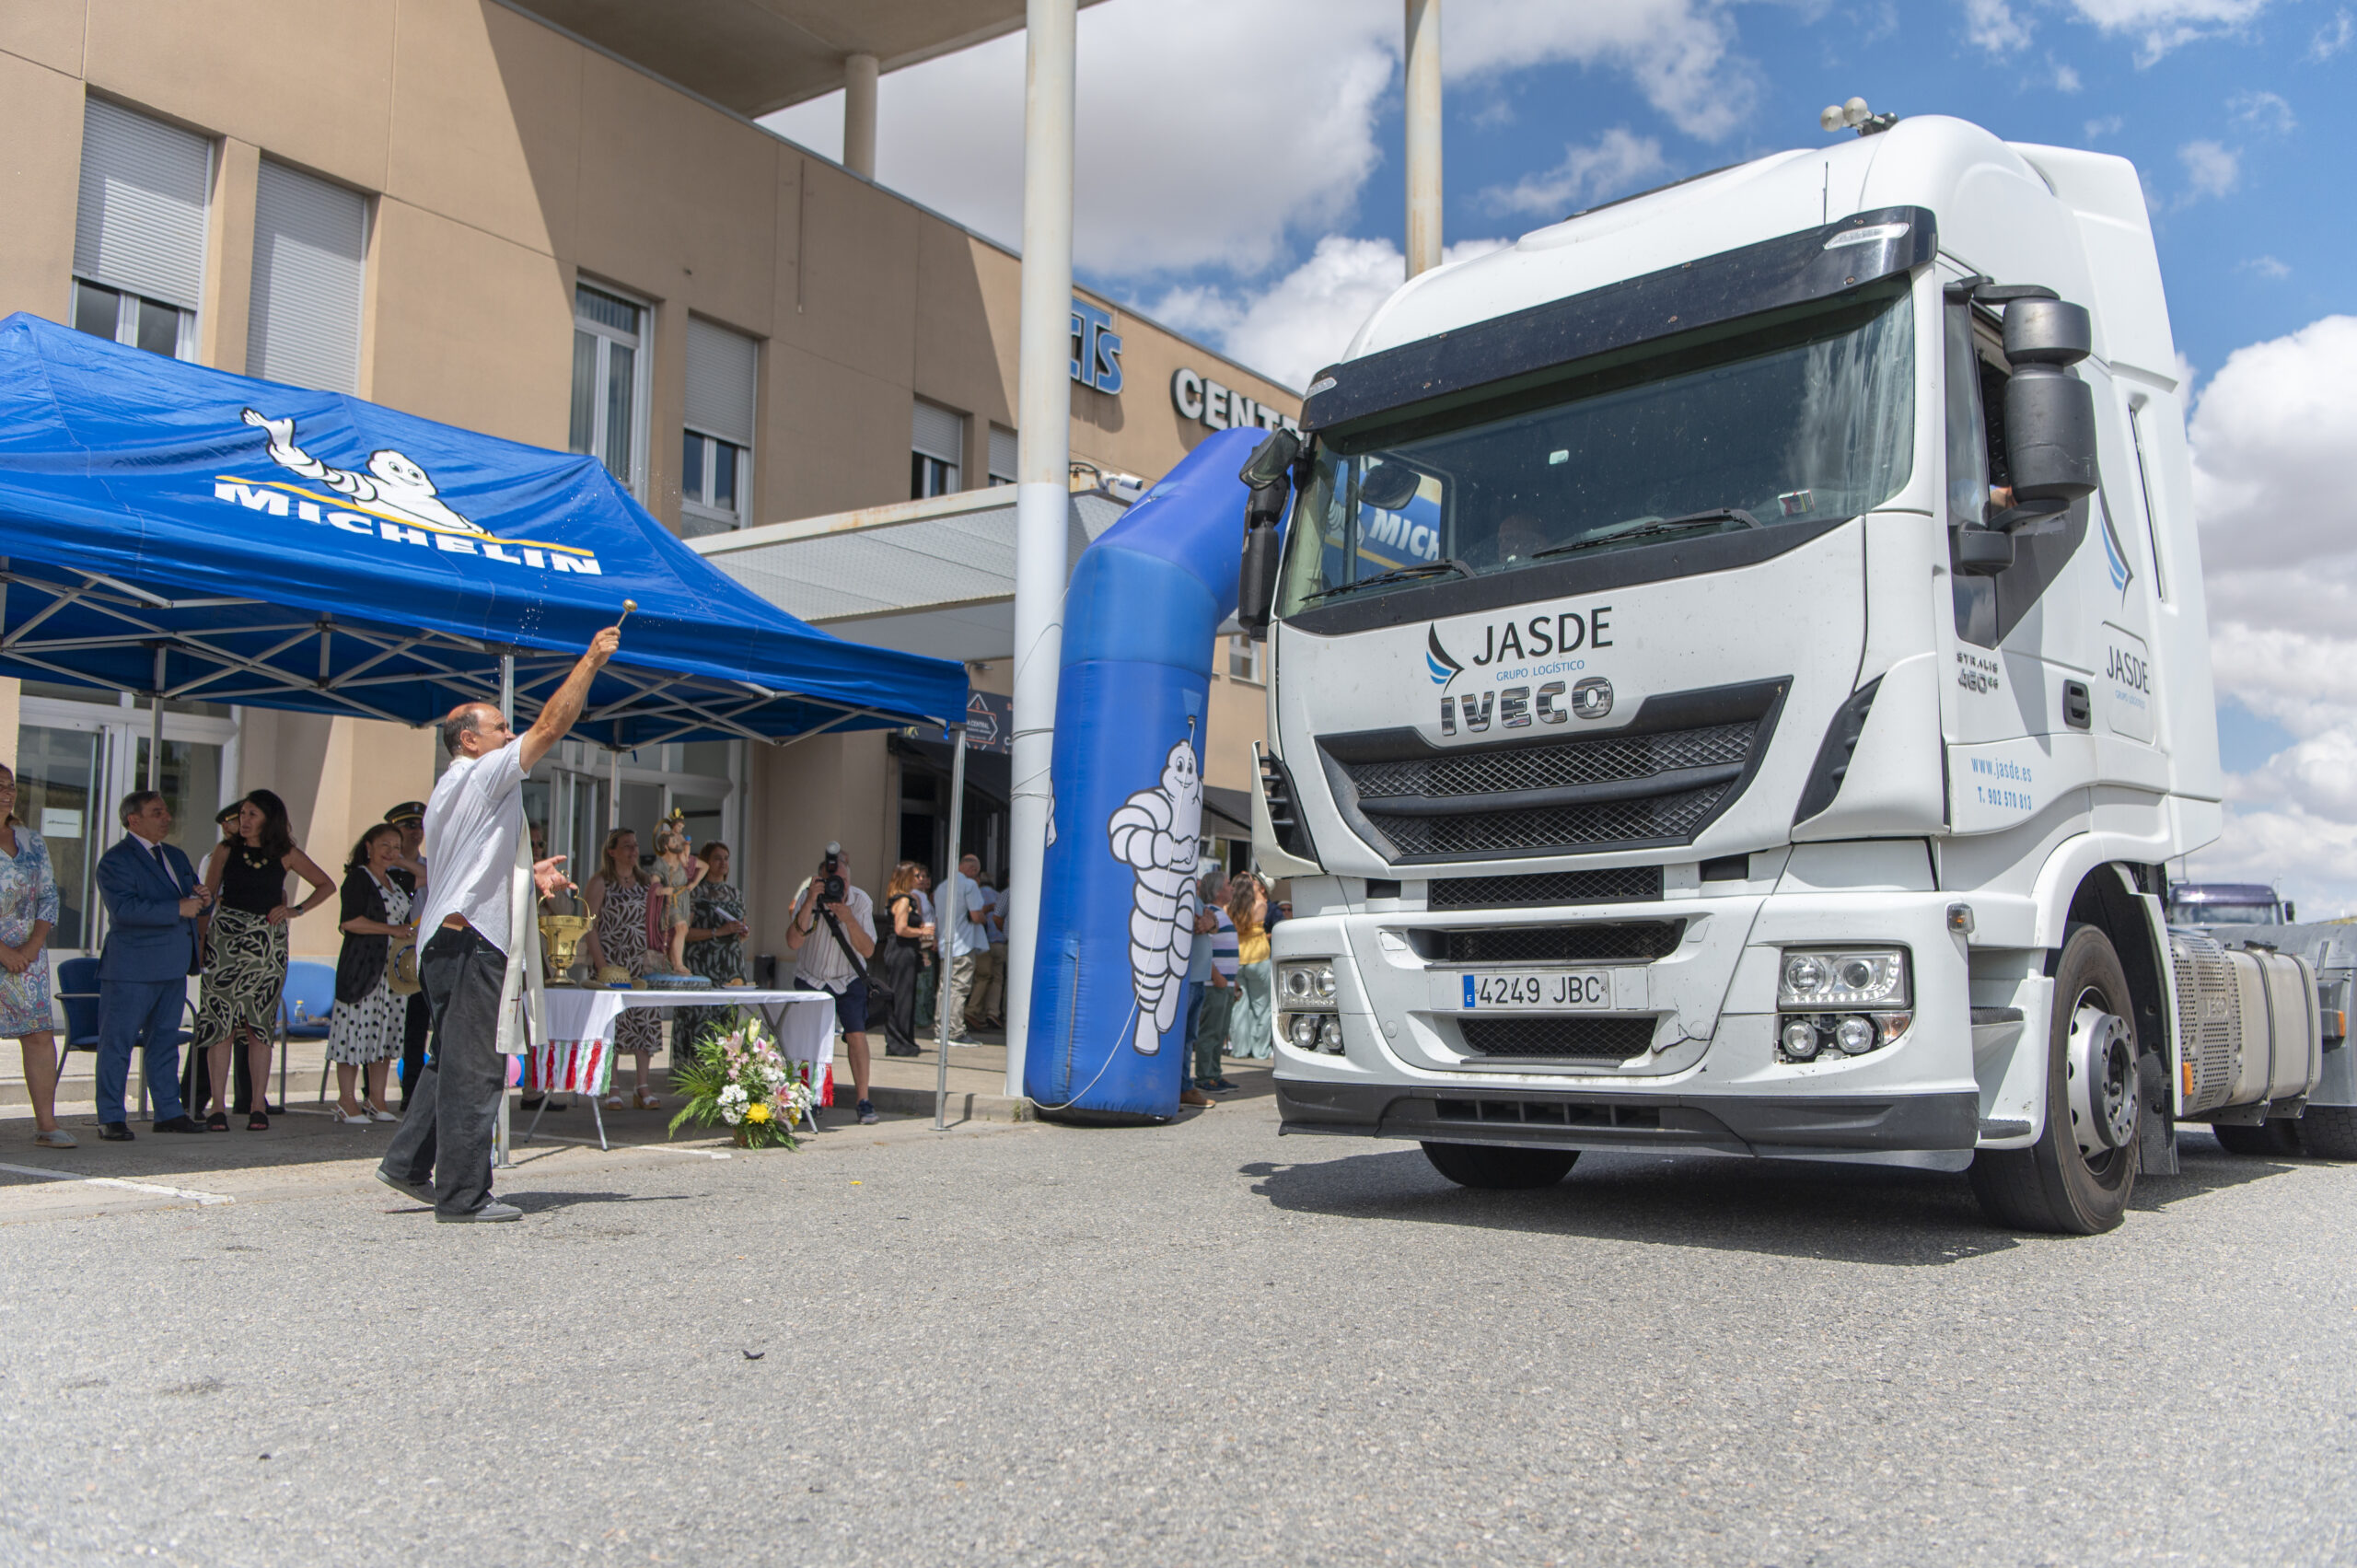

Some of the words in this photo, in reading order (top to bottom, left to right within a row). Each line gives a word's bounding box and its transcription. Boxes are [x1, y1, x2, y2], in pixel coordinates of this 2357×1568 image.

[1070, 296, 1123, 395] TS
[215, 482, 602, 575] MICHELIN
[1473, 606, 1613, 666] JASDE
[1496, 668, 1528, 681] GRUPO
[1533, 660, 1585, 676] LOGÍSTICO
[1956, 652, 1998, 674] STRALIS
[2107, 645, 2150, 695] JASDE
[1441, 677, 1614, 737] IVECO
[1971, 757, 2031, 783] www.jasde.es
[1978, 785, 1986, 804] T.
[1988, 788, 2002, 806] 902
[2004, 791, 2016, 808] 570
[2019, 793, 2031, 811] 813
[1467, 994, 1472, 1003] E
[1480, 978, 1540, 1004] 4249
[1553, 976, 1600, 1004] JBC
